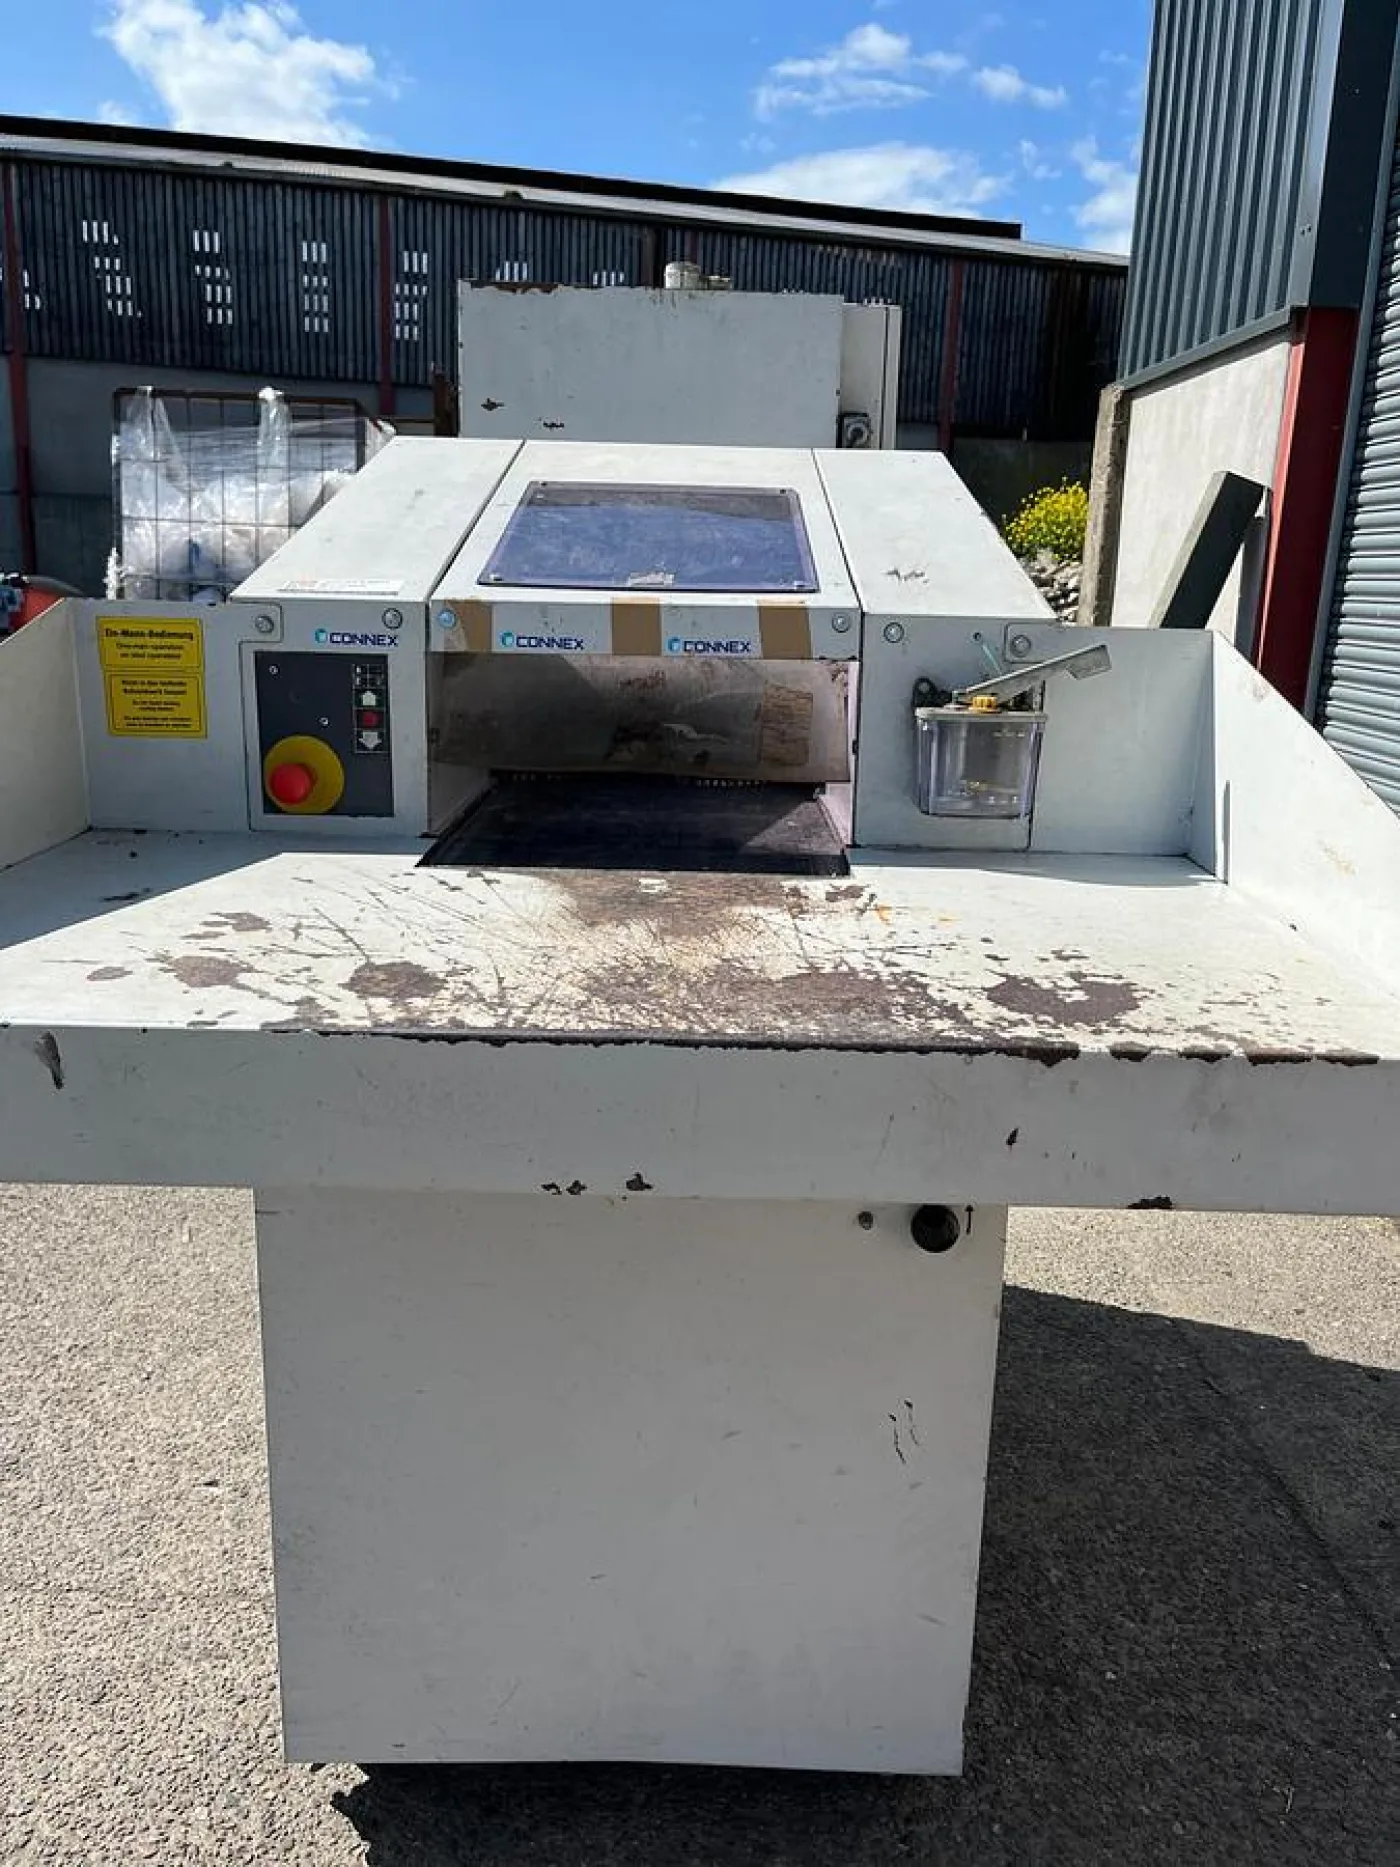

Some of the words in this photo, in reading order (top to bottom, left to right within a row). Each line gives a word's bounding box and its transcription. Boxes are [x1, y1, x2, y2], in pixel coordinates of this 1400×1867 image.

[329, 632, 398, 646] CONNEX
[516, 636, 584, 650] CONNEX
[683, 640, 750, 653] CONNEX
